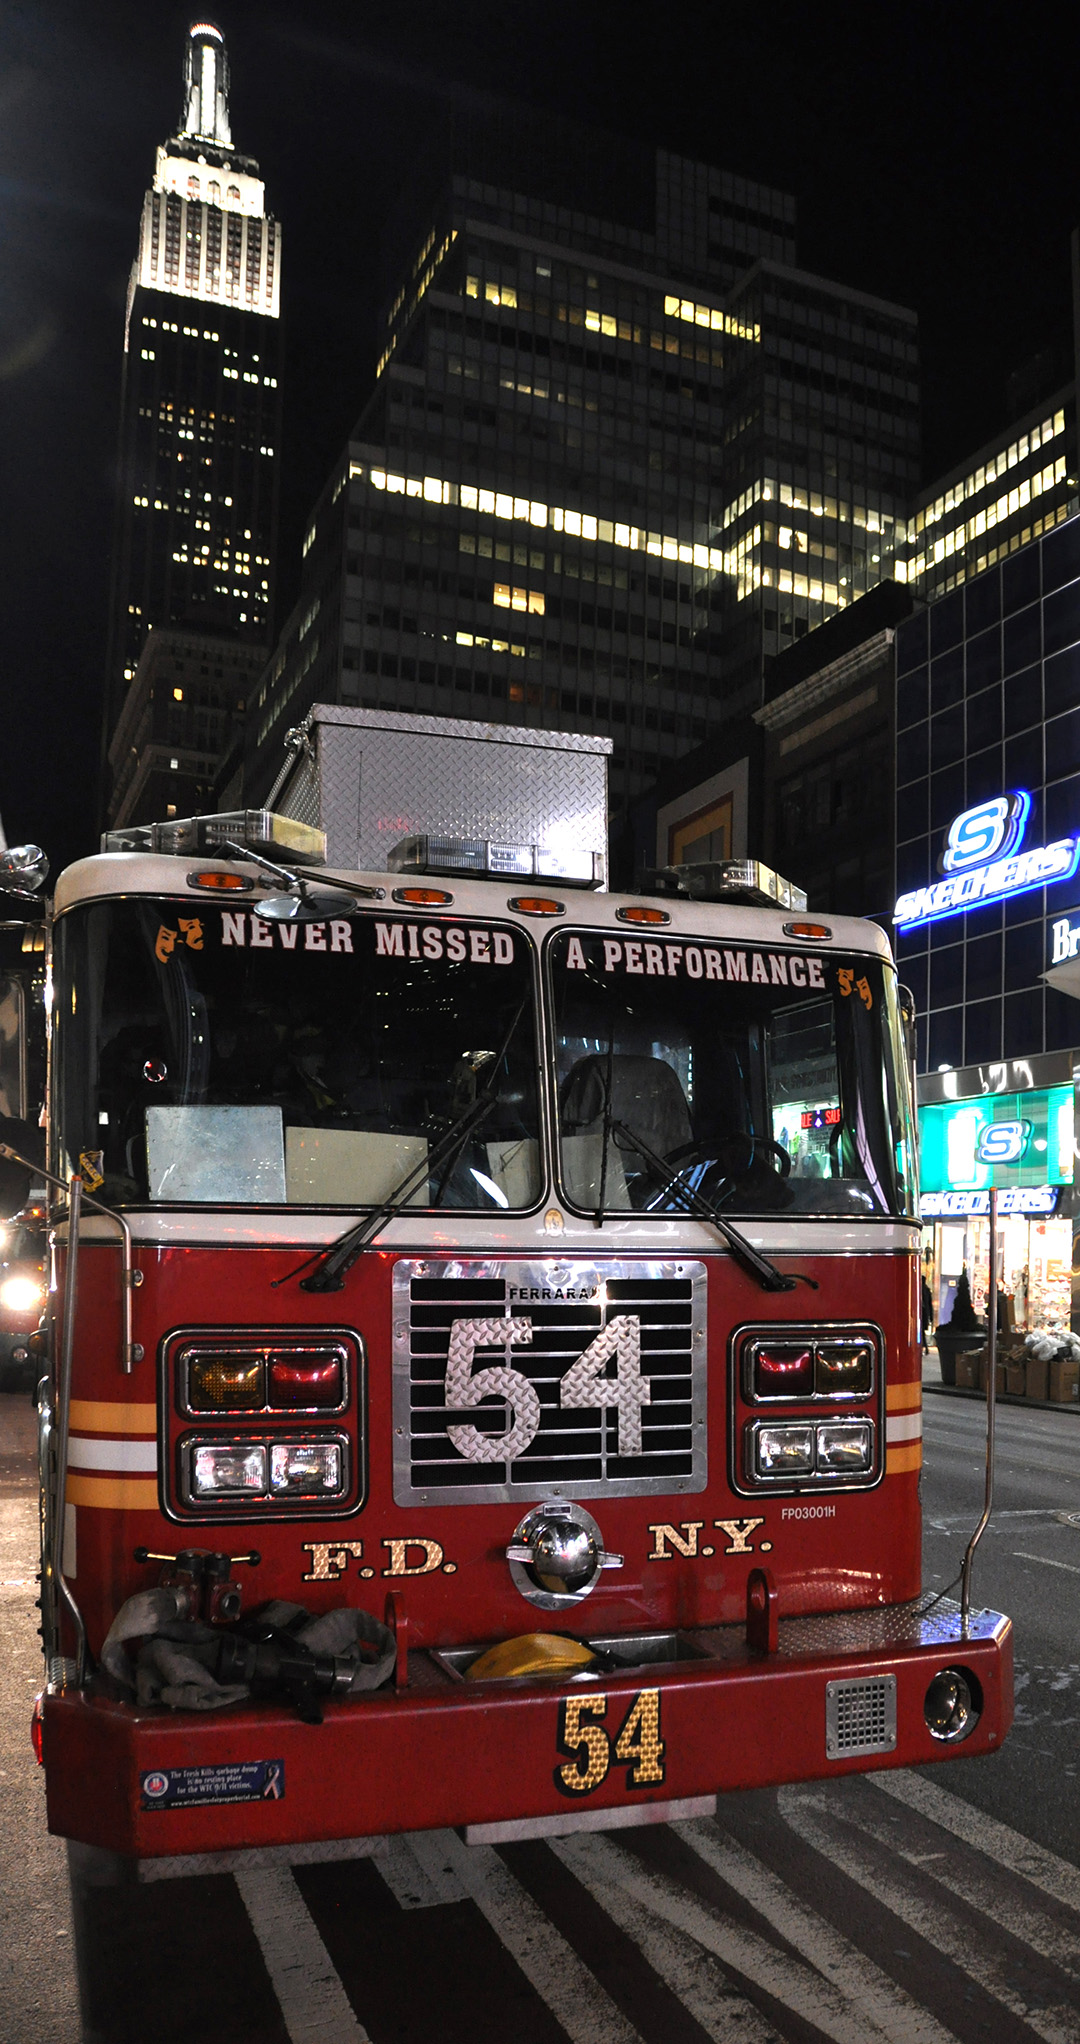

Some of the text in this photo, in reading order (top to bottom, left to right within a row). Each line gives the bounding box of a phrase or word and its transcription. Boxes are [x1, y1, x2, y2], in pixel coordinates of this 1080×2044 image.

[892, 838, 1074, 925] SKECHERS
[221, 911, 826, 989] NEVER MISSED A PERFORMANCE
[509, 1288, 589, 1300] FERRARA
[445, 1315, 650, 1463] 54
[781, 1505, 836, 1520] FP03001H
[303, 1517, 773, 1581] F.D. N.Y.
[560, 1687, 664, 1791] 54
[171, 1765, 258, 1779] The Fresh Kills garbage dump
[177, 1786, 186, 1794] for
[187, 1785, 198, 1793] the
[199, 1783, 213, 1792] WTC
[204, 1775, 225, 1784] resting
[226, 1774, 242, 1783] place
